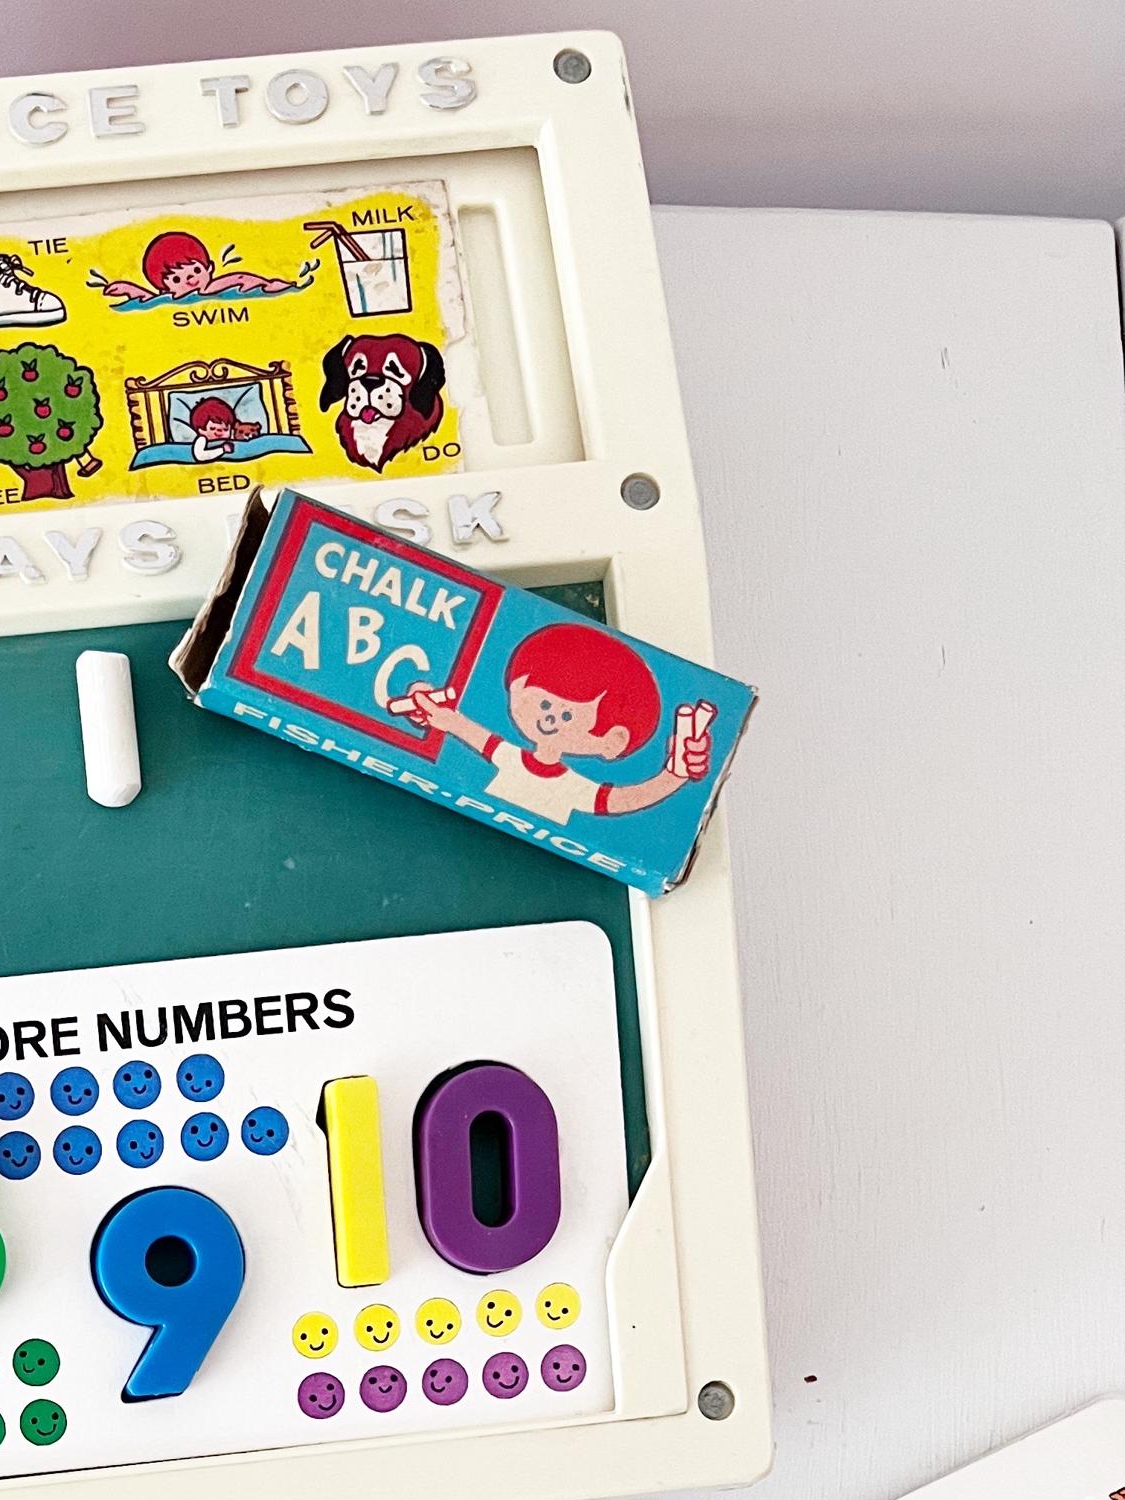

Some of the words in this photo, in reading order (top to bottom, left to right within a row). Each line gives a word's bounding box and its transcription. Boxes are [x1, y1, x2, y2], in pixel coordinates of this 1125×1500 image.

[200, 56, 479, 127] TOYS
[352, 206, 416, 227] MILK
[27, 236, 69, 256] TIE
[172, 306, 250, 328] SWIM
[198, 474, 251, 495] BED
[314, 542, 467, 630] CHALK
[97, 988, 355, 1051] NUMBERS
[90, 1186, 246, 1402] 9
[318, 1061, 563, 1288] 10
